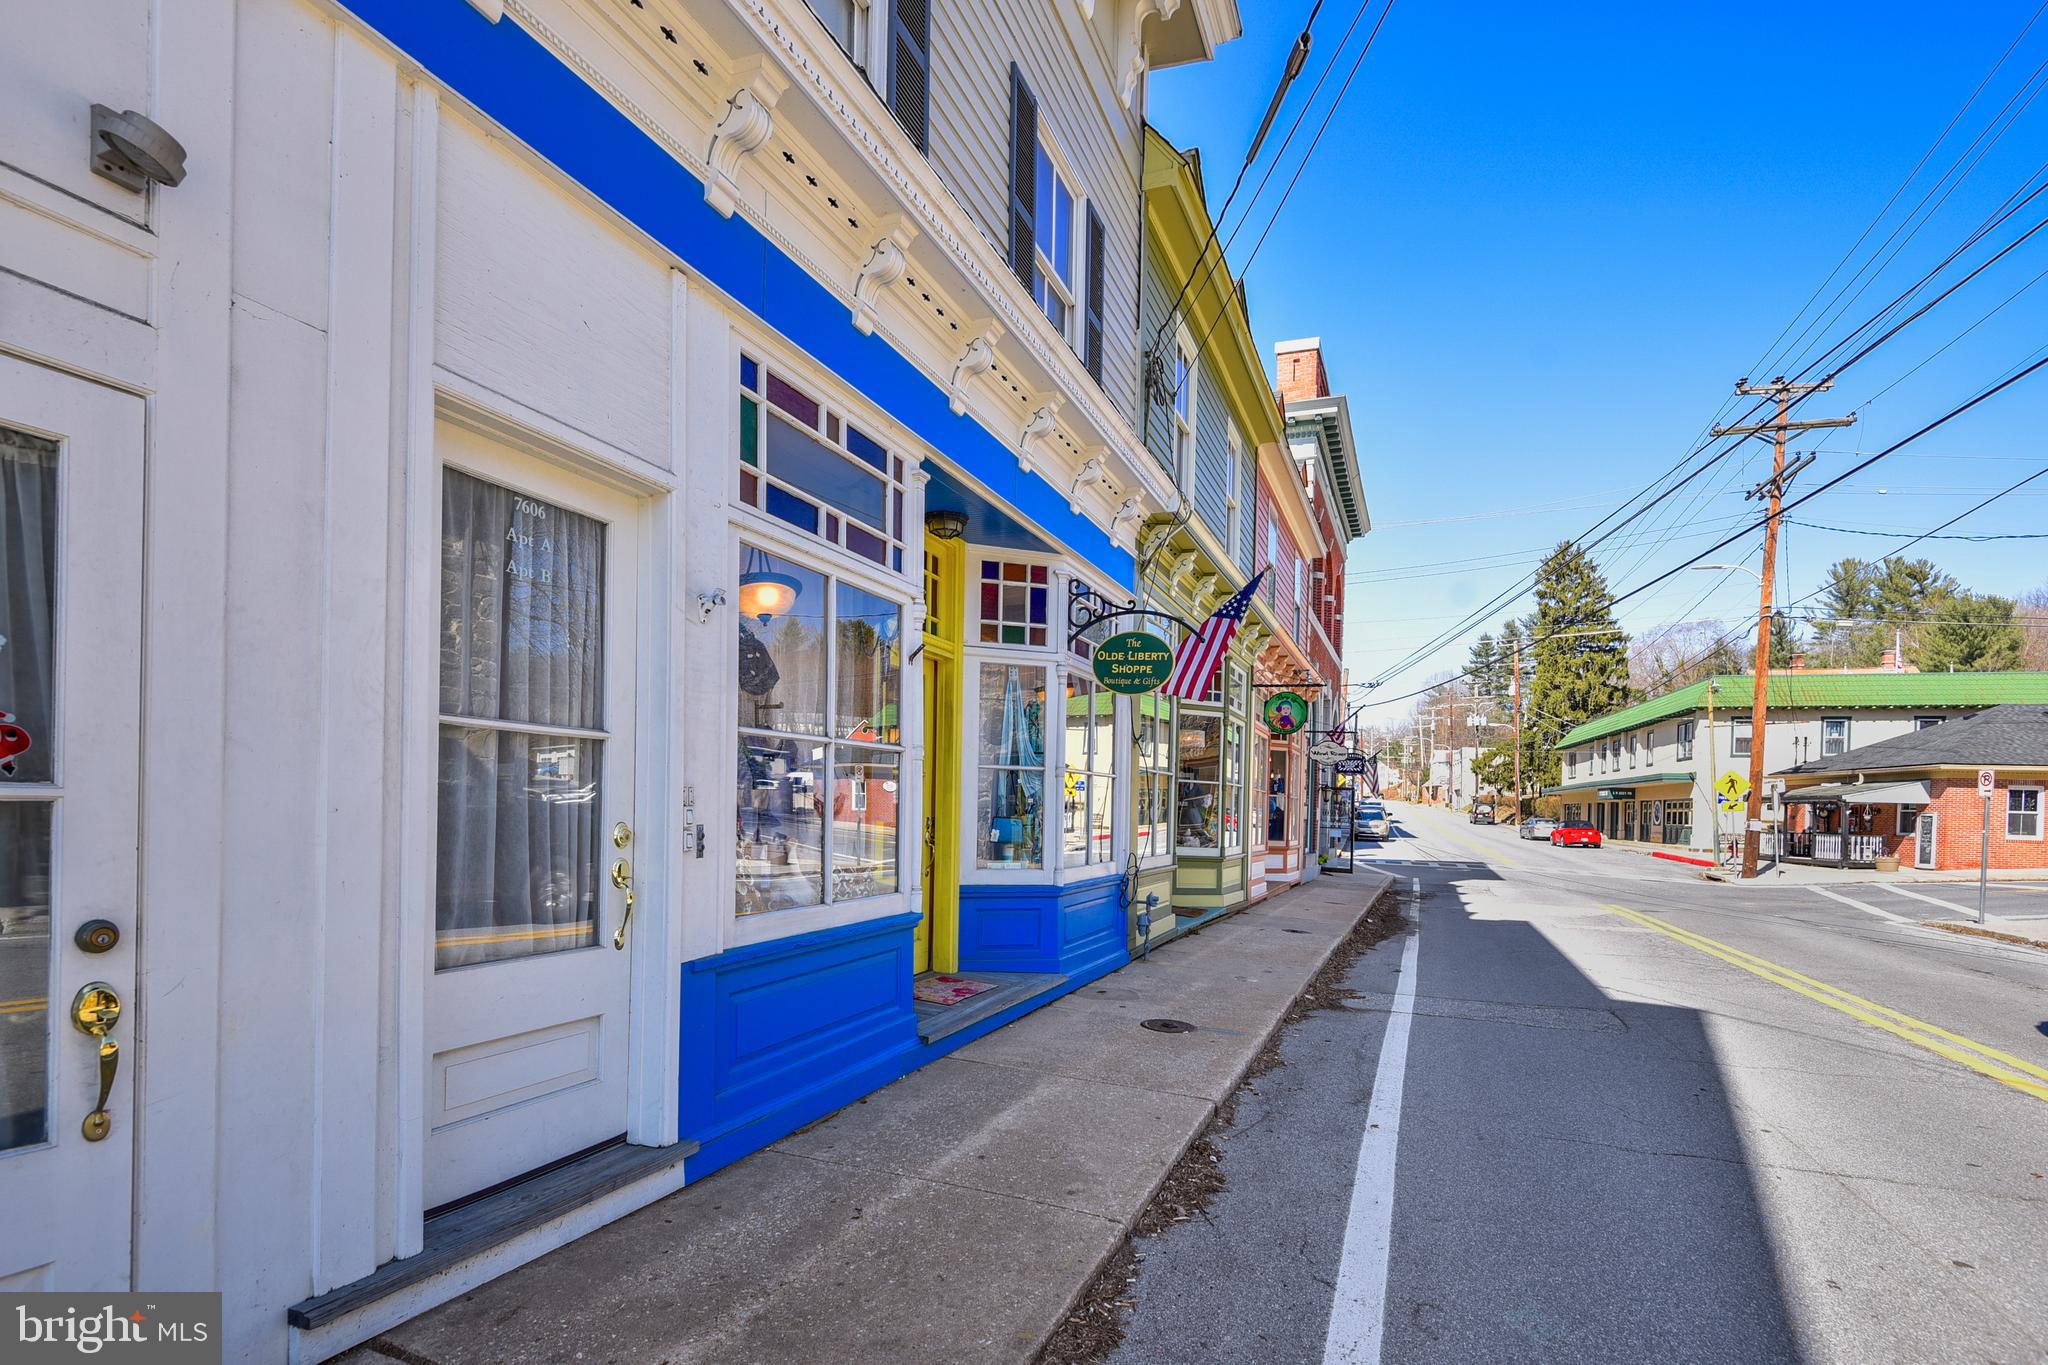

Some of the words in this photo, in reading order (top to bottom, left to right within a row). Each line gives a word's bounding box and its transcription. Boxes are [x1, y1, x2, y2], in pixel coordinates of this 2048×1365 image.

[514, 497, 546, 519] 7606
[505, 527, 534, 548] Apt
[541, 538, 553, 553] A
[505, 559, 534, 580] Apt
[541, 569, 553, 583] B
[1127, 638, 1141, 647] The
[1098, 651, 1124, 660] OLDE
[1128, 651, 1169, 660] LIBERTY
[1112, 664, 1152, 673] SHOPPE
[1104, 677, 1131, 686] Boutique
[1142, 677, 1159, 687] Gifts
